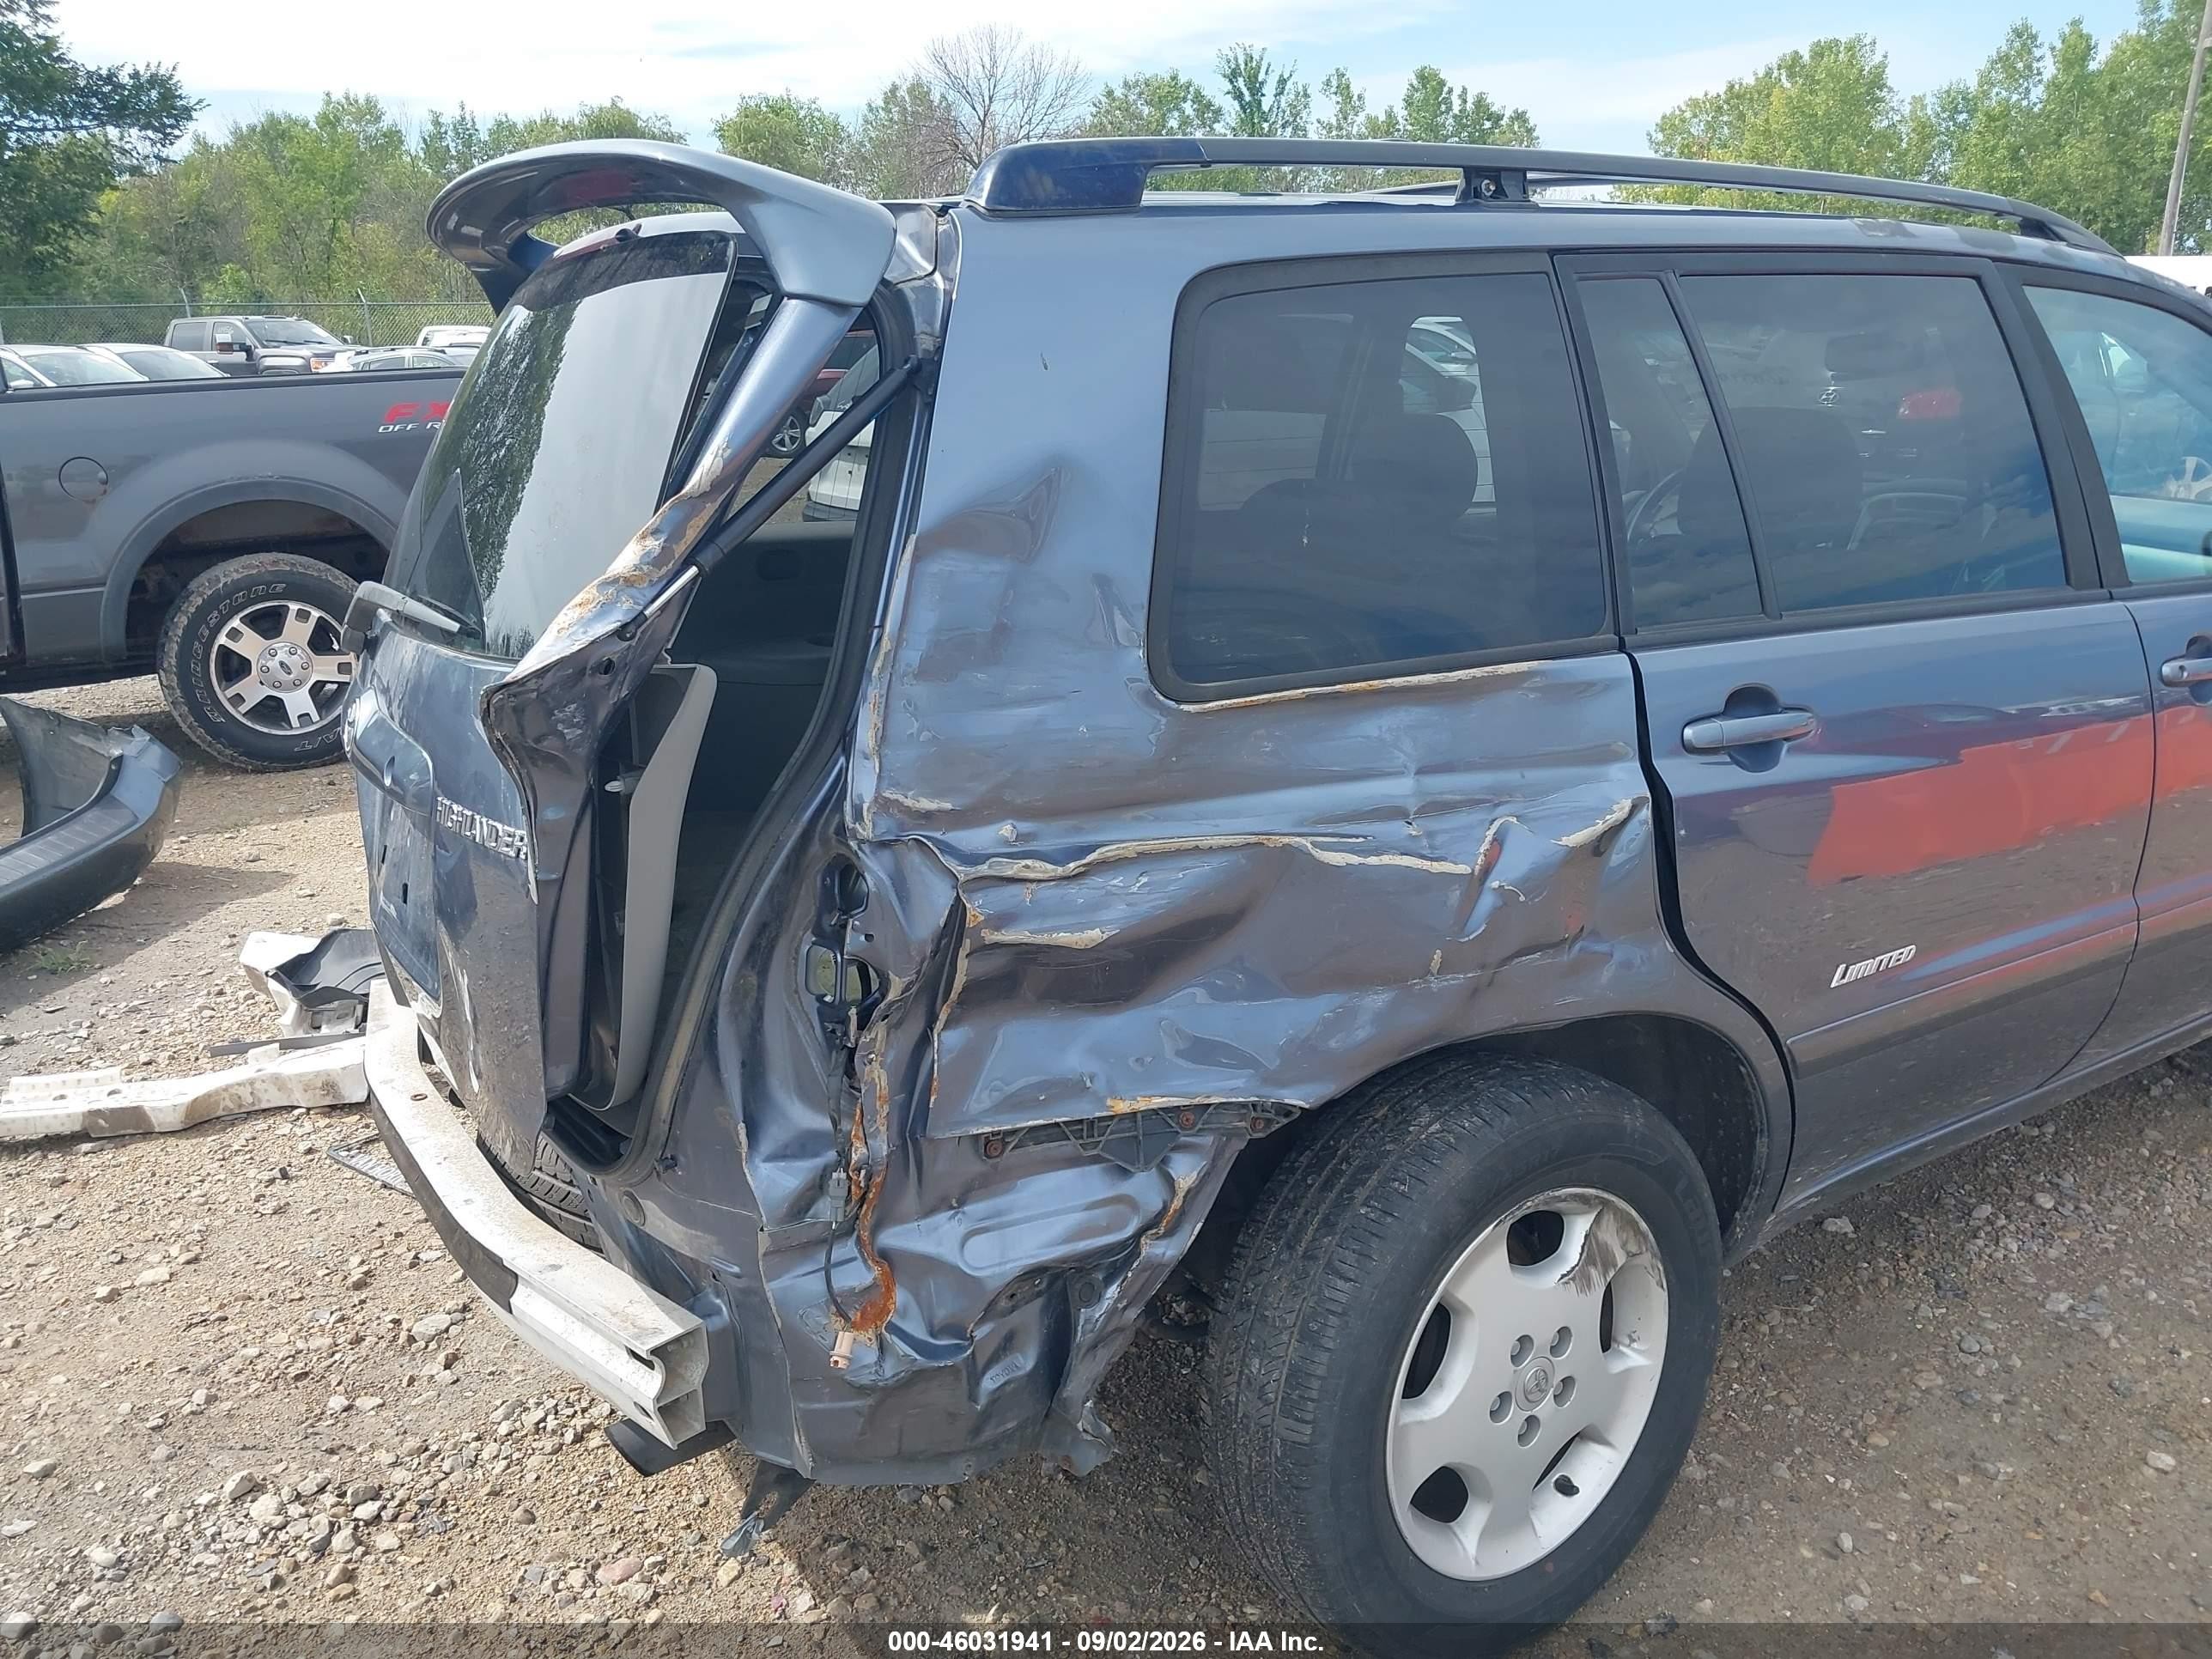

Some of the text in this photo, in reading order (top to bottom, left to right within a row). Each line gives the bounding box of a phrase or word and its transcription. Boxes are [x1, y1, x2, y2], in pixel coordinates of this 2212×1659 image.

[378, 422, 419, 433] OFF
[384, 401, 451, 423] FX
[191, 583, 287, 723] BRIDGESTONE
[436, 796, 527, 860] HIGHLANDER
[1829, 945, 1917, 988] LIMITED
